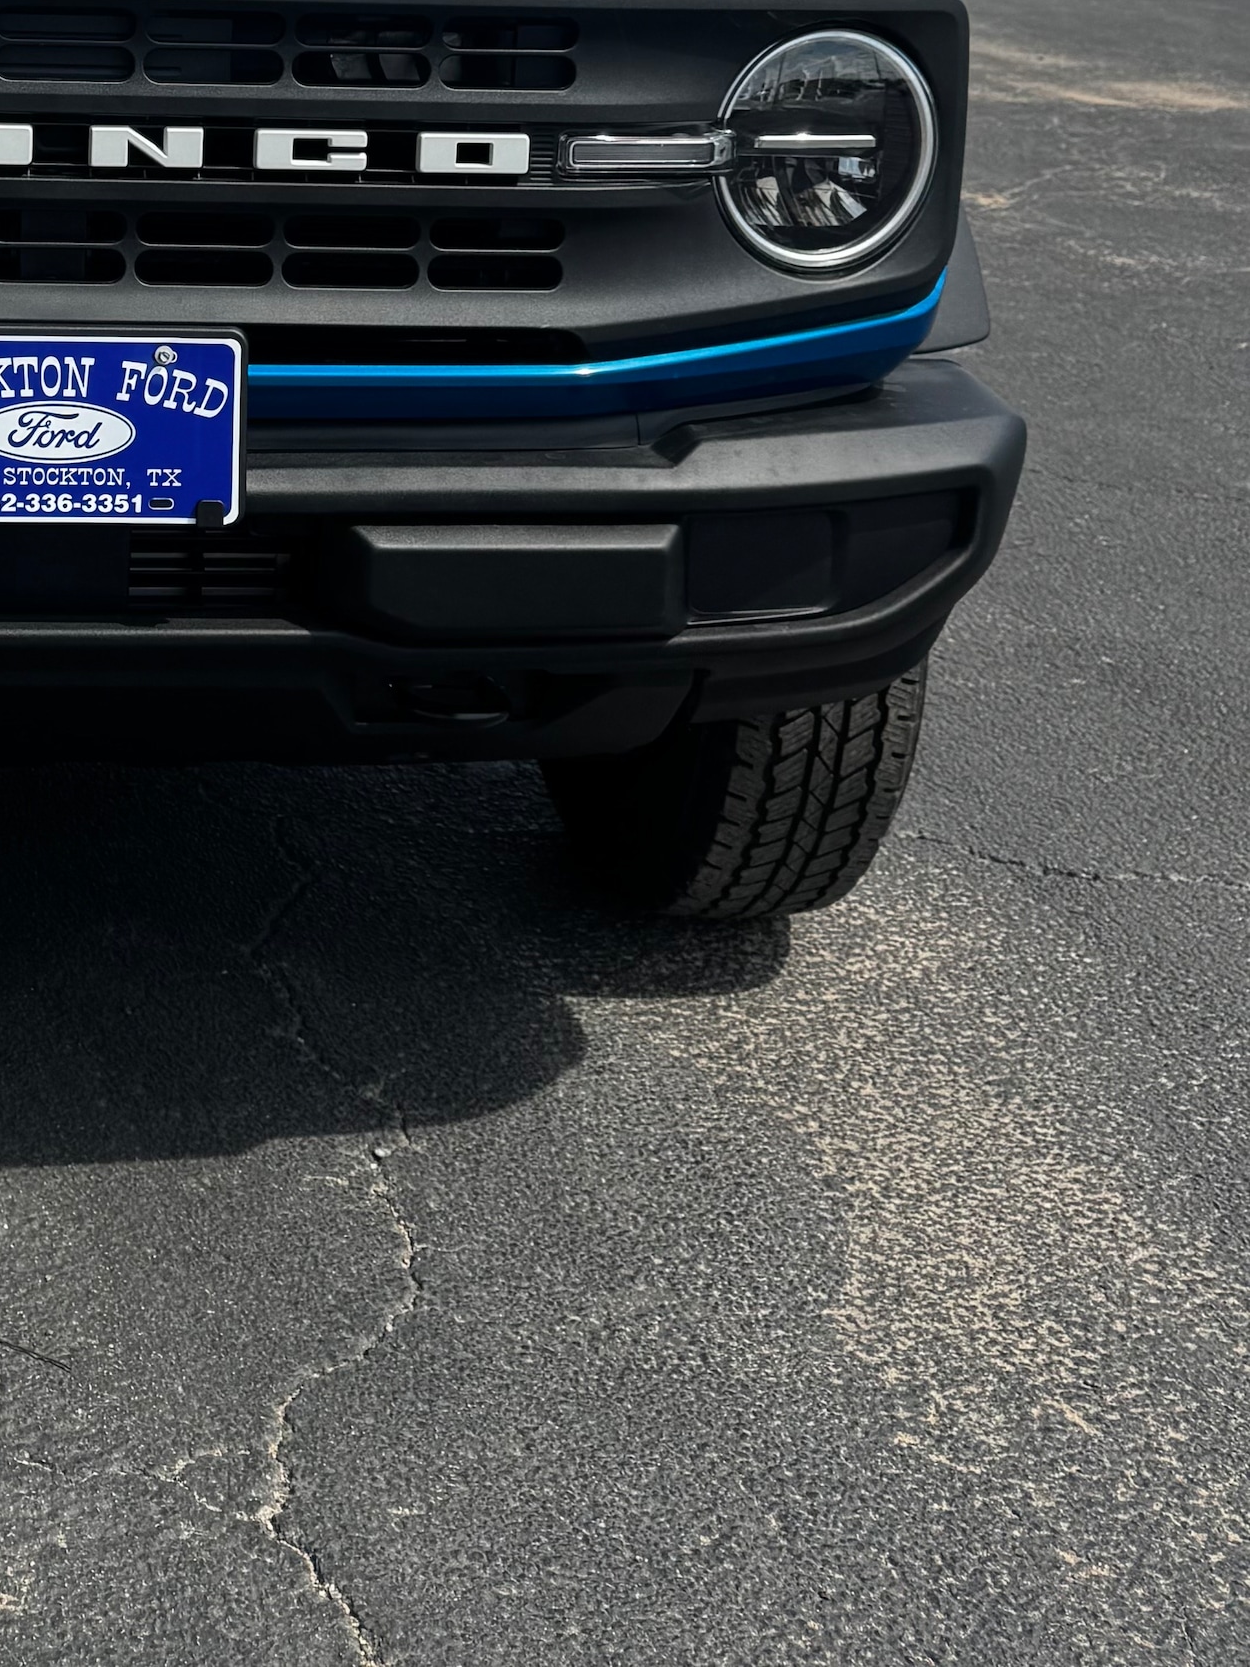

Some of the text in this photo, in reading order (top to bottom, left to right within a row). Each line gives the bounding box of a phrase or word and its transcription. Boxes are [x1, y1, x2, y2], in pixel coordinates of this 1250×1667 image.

[116, 361, 228, 418] FORD
[8, 411, 102, 448] Ford
[3, 466, 132, 489] STOCKTON,
[146, 468, 183, 487] TX
